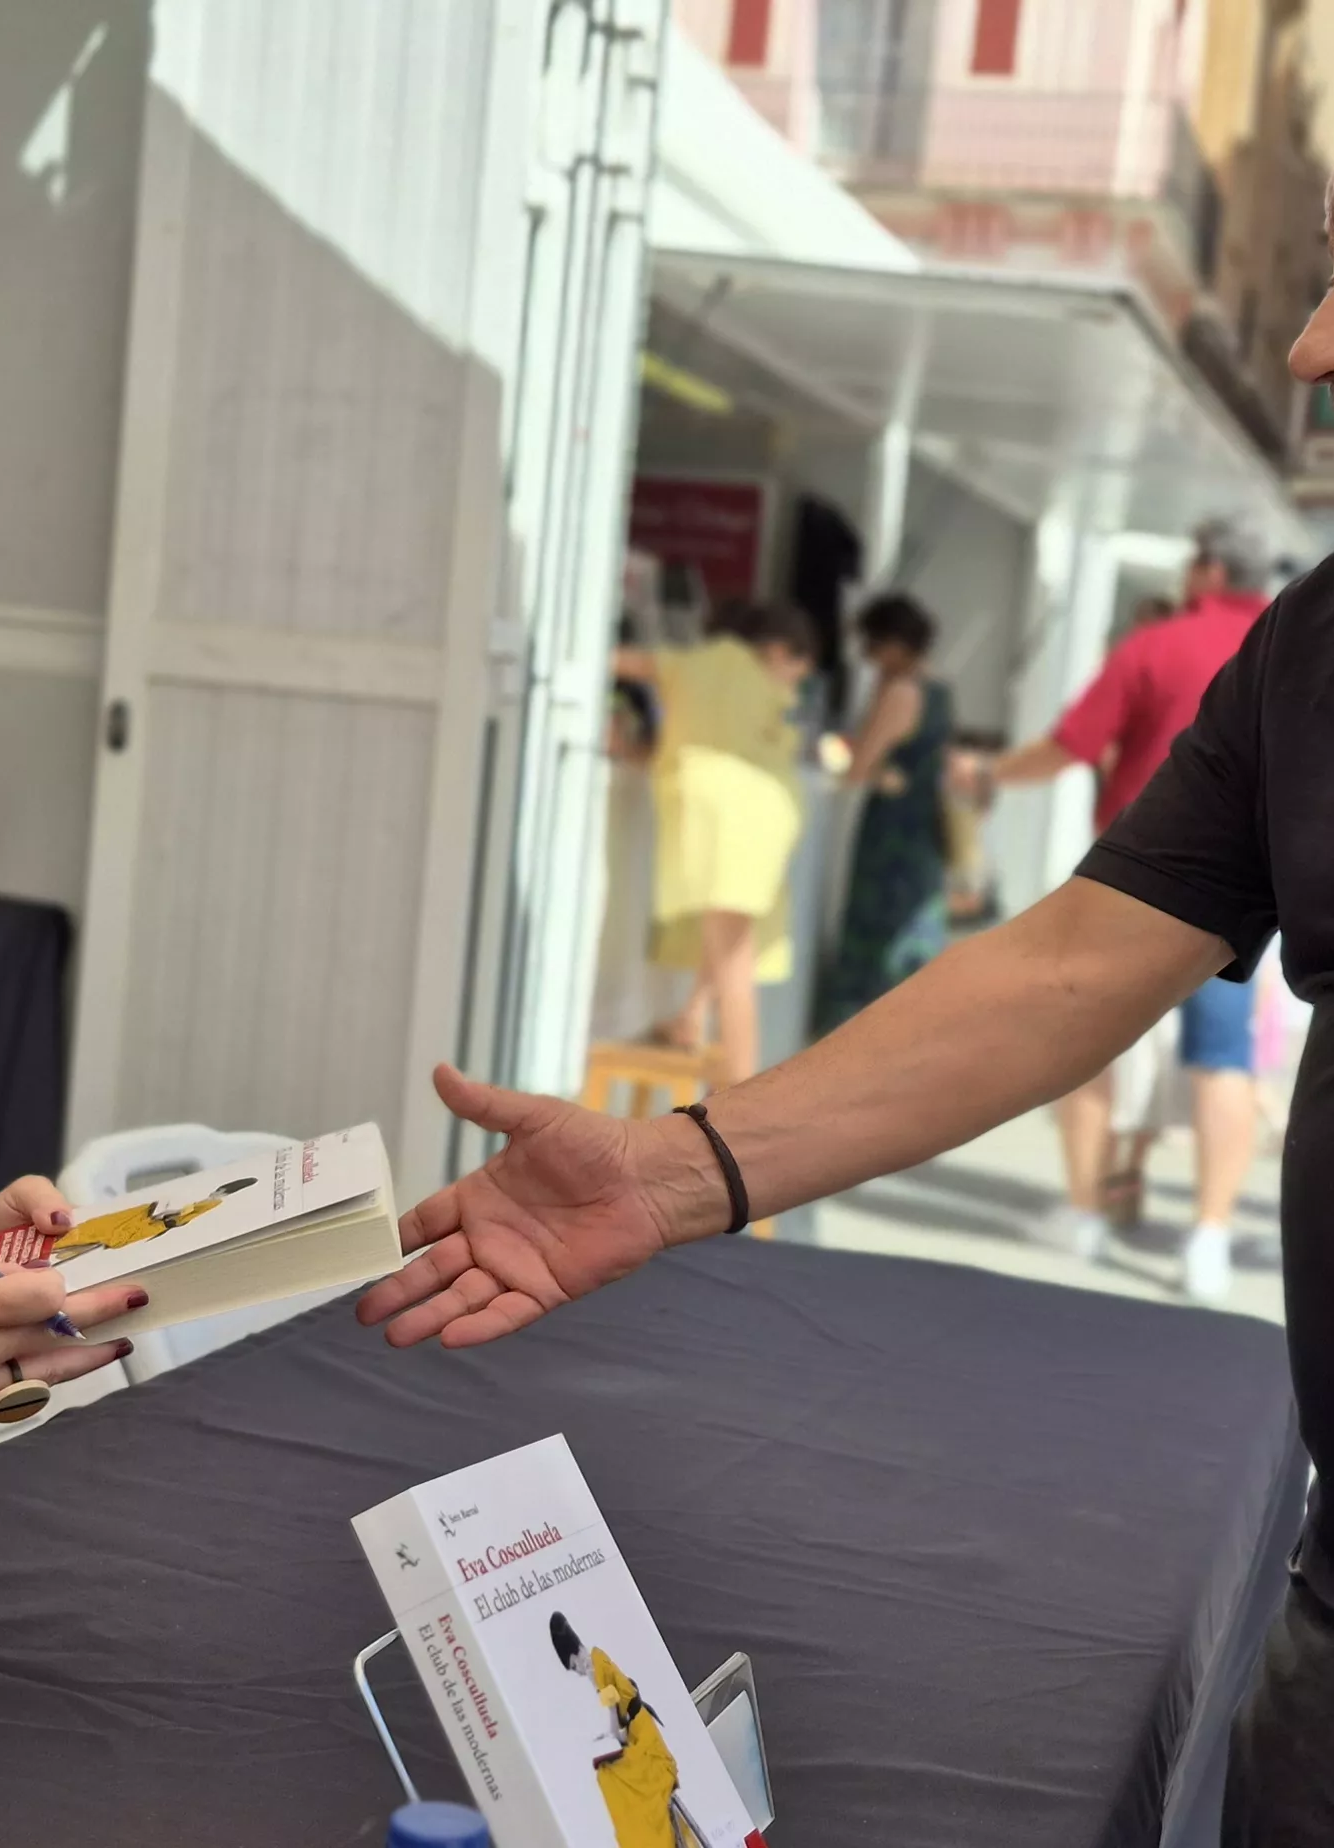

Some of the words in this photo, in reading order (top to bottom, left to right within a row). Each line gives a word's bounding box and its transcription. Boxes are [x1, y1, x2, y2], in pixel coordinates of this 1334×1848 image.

[457, 1557, 488, 1584] Eva
[486, 1521, 563, 1569] Cosculluela
[473, 1593, 494, 1621] El
[492, 1582, 520, 1613] club
[520, 1576, 537, 1600] de
[532, 1569, 555, 1592] las
[552, 1548, 606, 1585] modernas
[418, 1623, 435, 1642] El
[427, 1644, 449, 1676] club
[443, 1678, 457, 1698] de
[452, 1698, 465, 1722] las
[462, 1724, 502, 1802] modernas
[438, 1613, 456, 1644] Eva
[453, 1646, 498, 1740] Cosculluela
